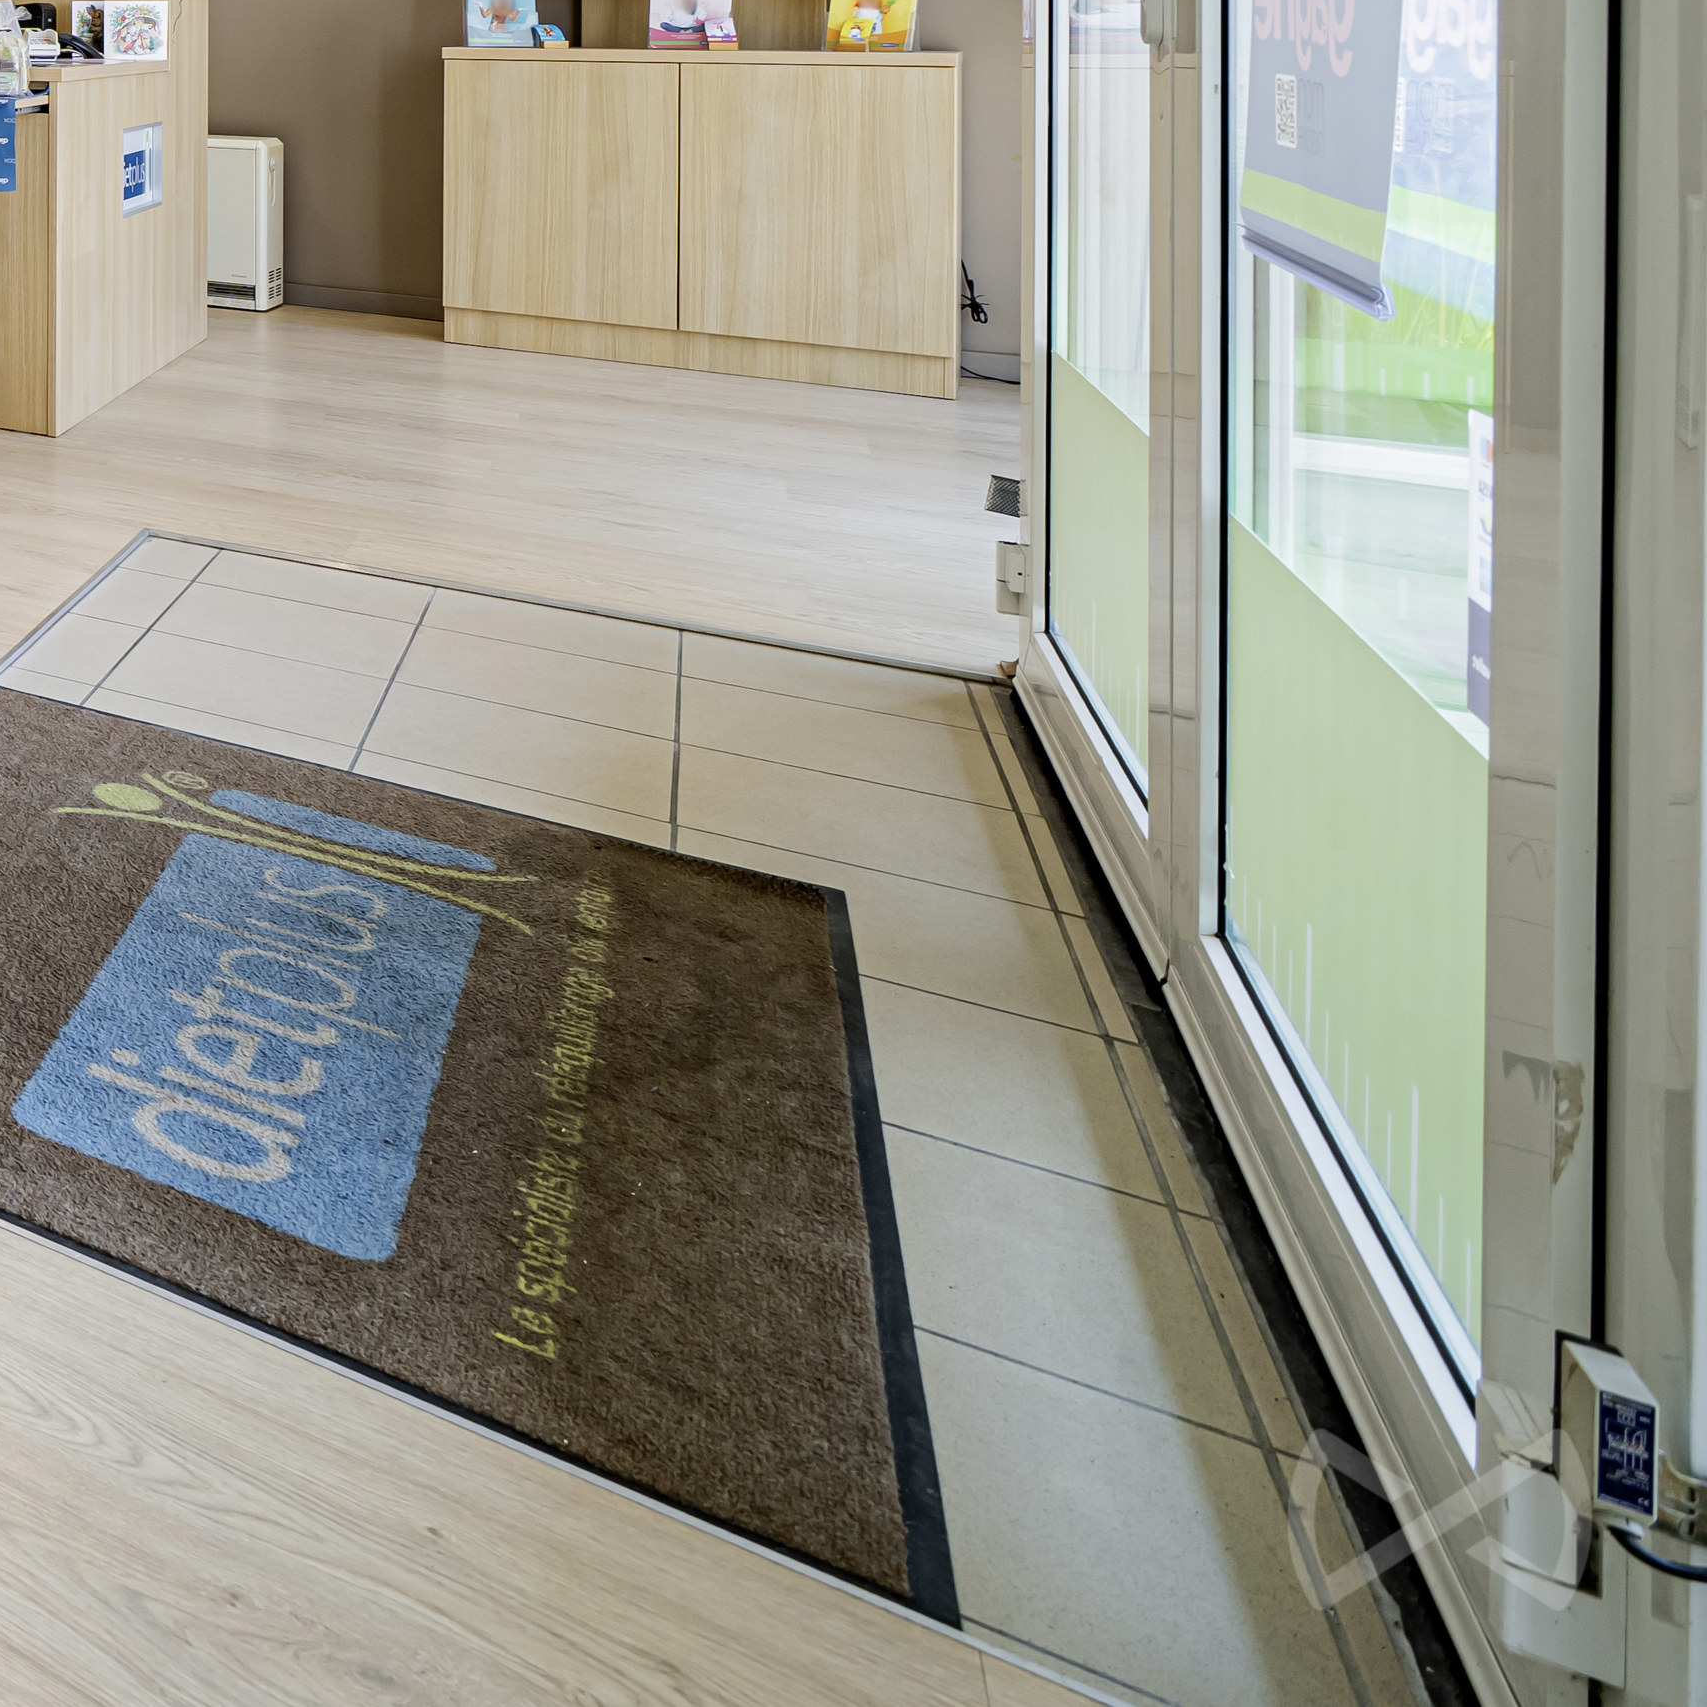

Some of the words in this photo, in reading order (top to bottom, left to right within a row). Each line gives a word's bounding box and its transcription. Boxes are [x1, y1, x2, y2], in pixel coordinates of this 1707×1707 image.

[123, 156, 145, 193] etplus
[87, 865, 402, 1184] dietplus
[490, 1305, 559, 1360] Le
